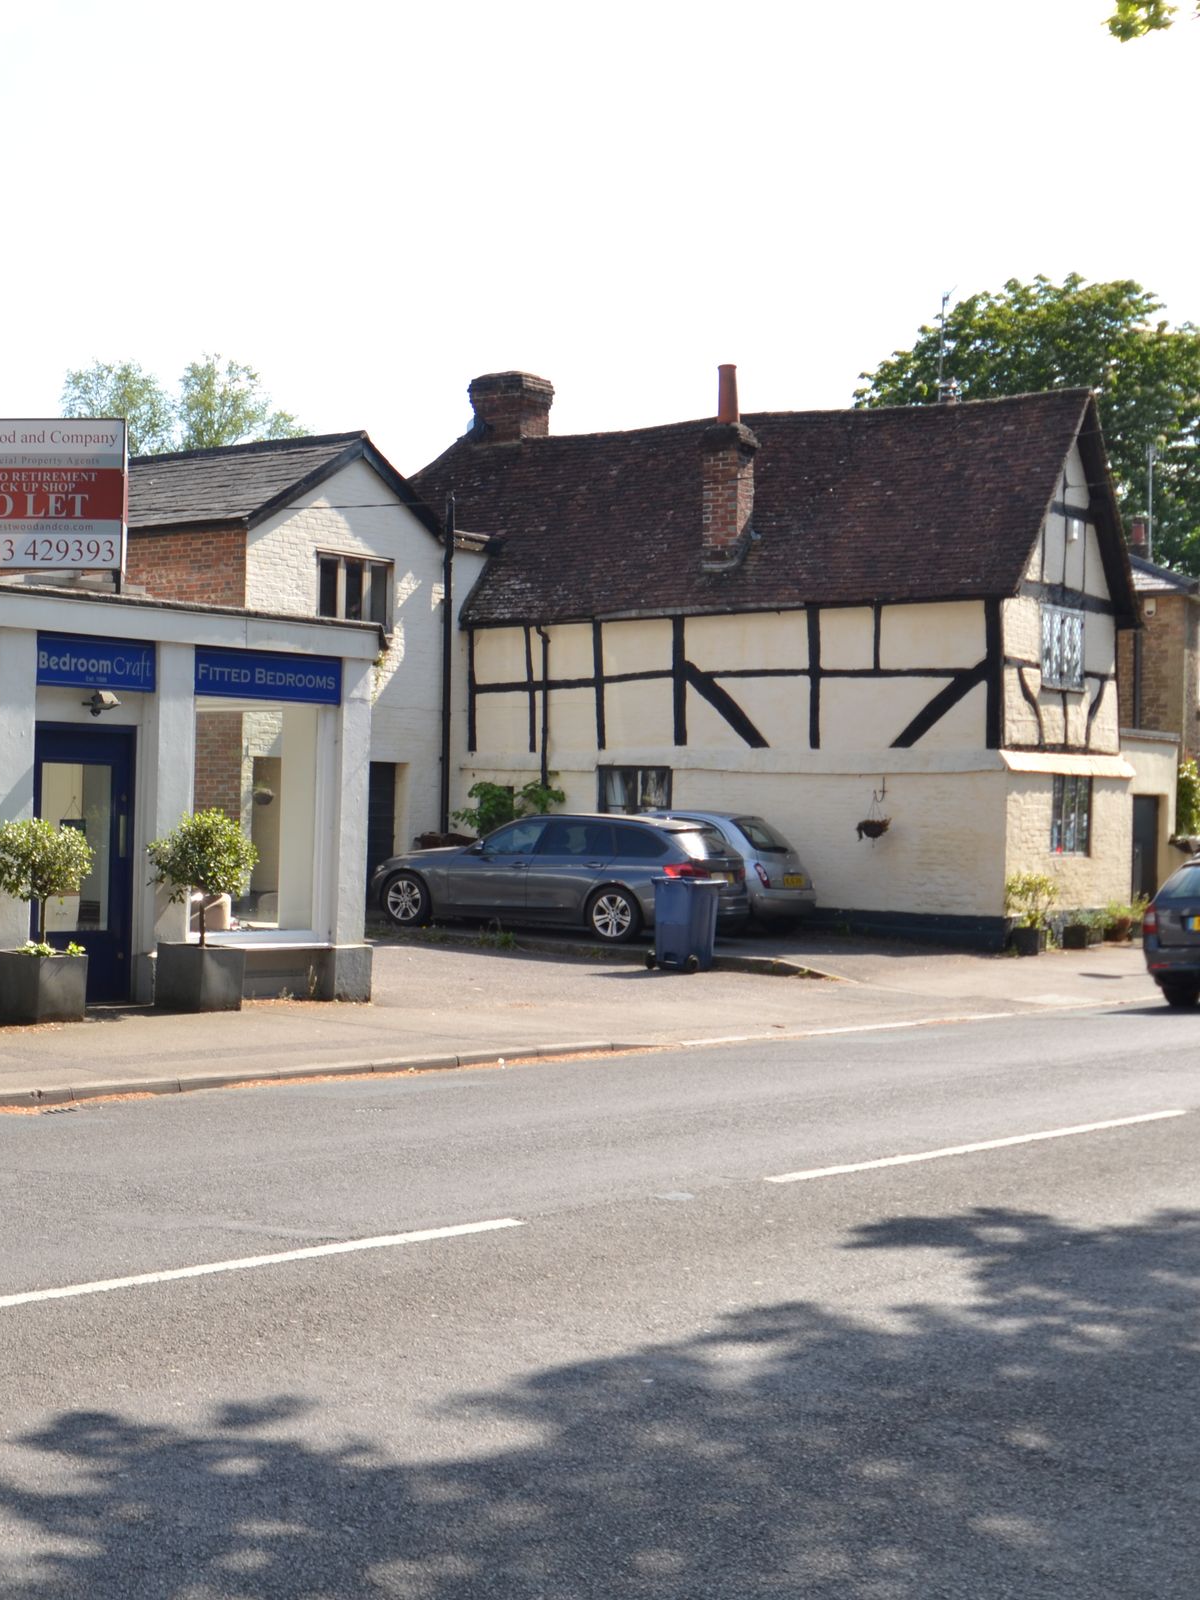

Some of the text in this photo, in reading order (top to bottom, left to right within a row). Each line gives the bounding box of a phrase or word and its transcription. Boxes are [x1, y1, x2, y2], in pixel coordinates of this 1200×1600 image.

[20, 431, 45, 444] and
[50, 431, 118, 447] Company
[21, 456, 62, 466] Property
[66, 457, 100, 466] Agents
[14, 472, 98, 482] RETIREMENT
[22, 483, 39, 492] UP
[42, 483, 76, 492] SHOP
[24, 494, 88, 517] LET
[24, 539, 115, 562] 429393
